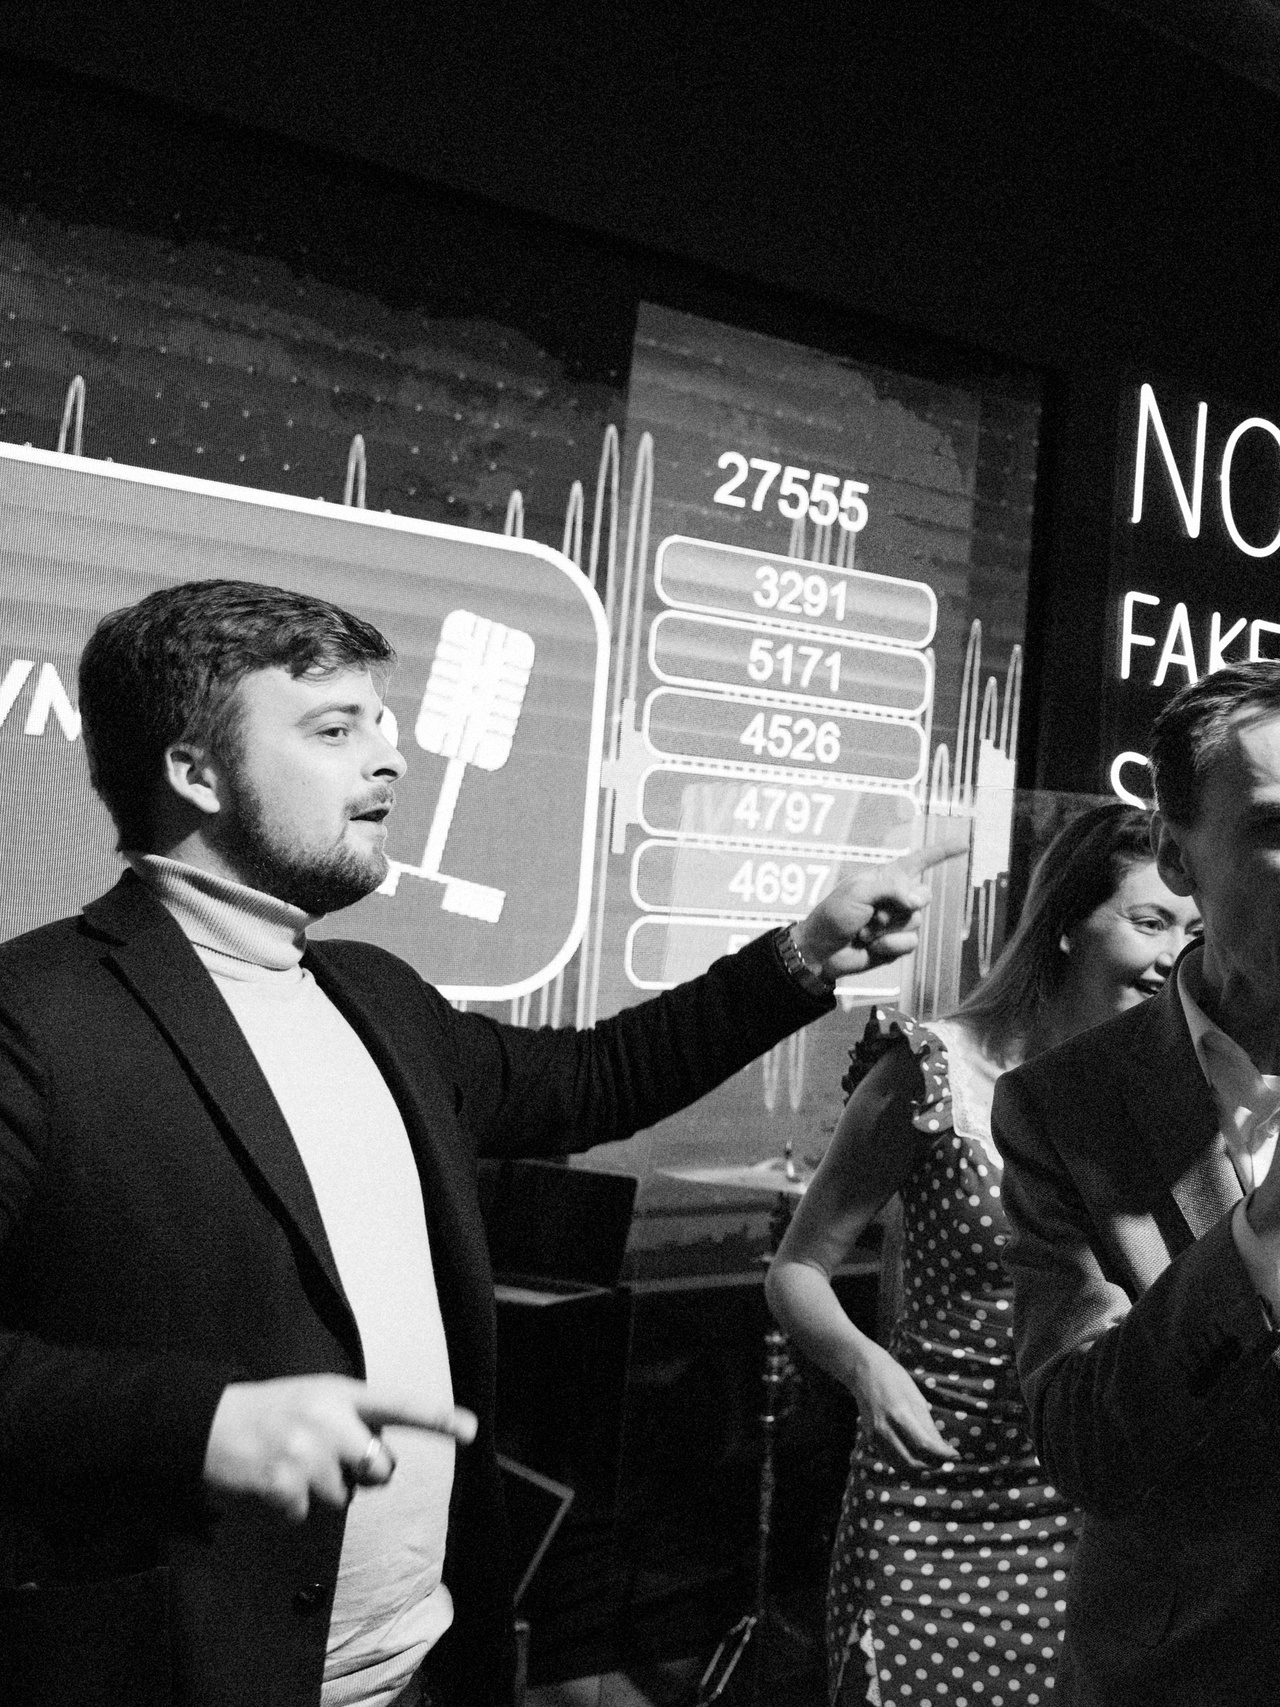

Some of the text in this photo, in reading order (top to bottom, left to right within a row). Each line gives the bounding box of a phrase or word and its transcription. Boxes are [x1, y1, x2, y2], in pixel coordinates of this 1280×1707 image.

[713, 450, 870, 533] 27555
[752, 565, 848, 622] 3291
[747, 639, 842, 692] 5171
[739, 713, 841, 764] 4526
[734, 787, 834, 835] 4797
[728, 860, 830, 904] 4697
